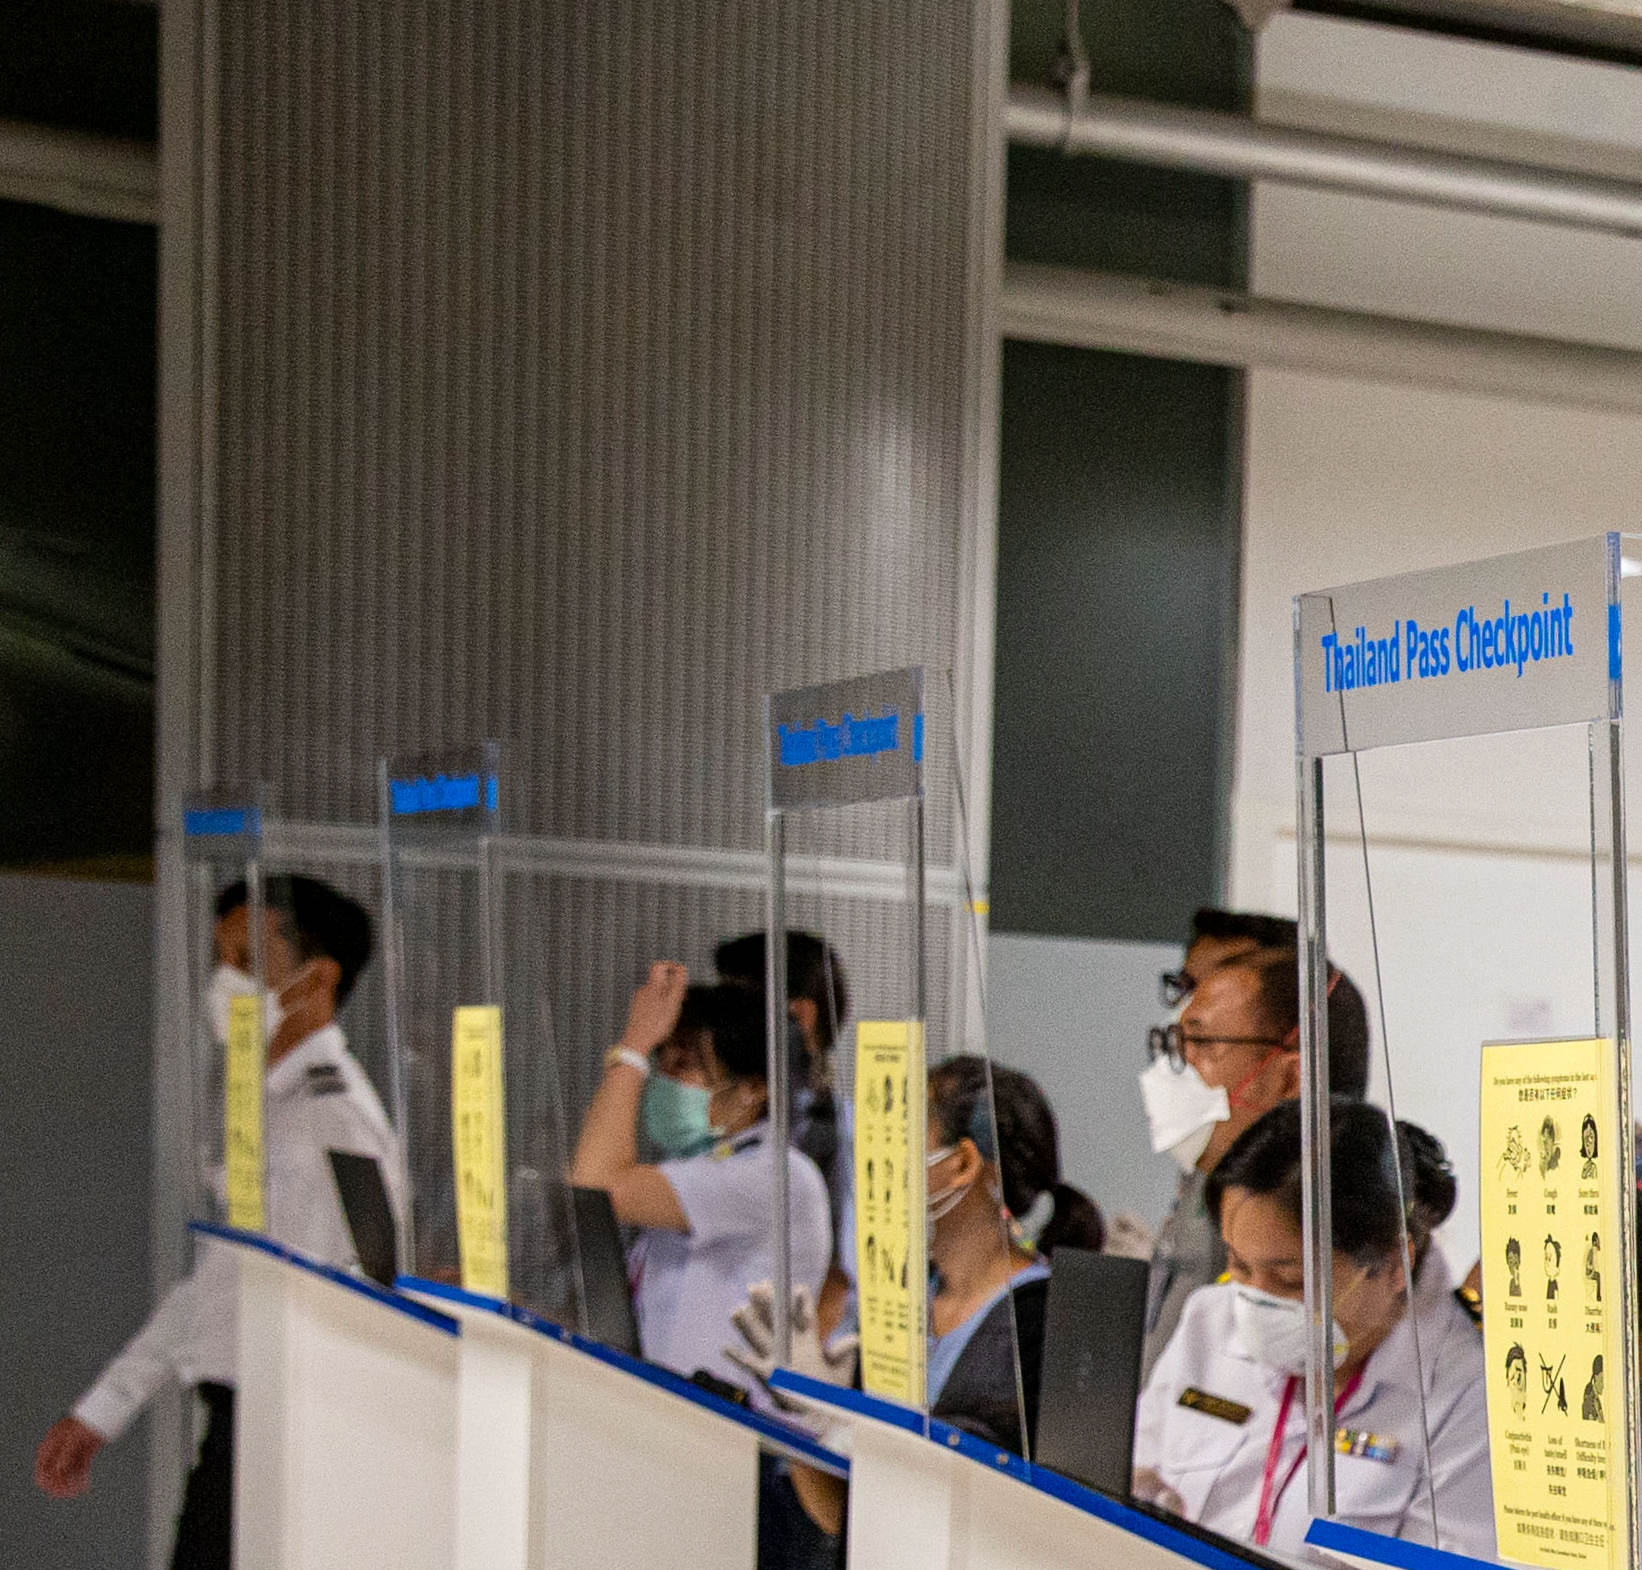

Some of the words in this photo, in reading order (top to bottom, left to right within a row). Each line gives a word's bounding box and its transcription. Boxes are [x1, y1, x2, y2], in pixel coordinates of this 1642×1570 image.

[1321, 620, 1400, 692] Thailand
[1406, 620, 1450, 679] Pass
[1455, 592, 1573, 678] Checkpoint
